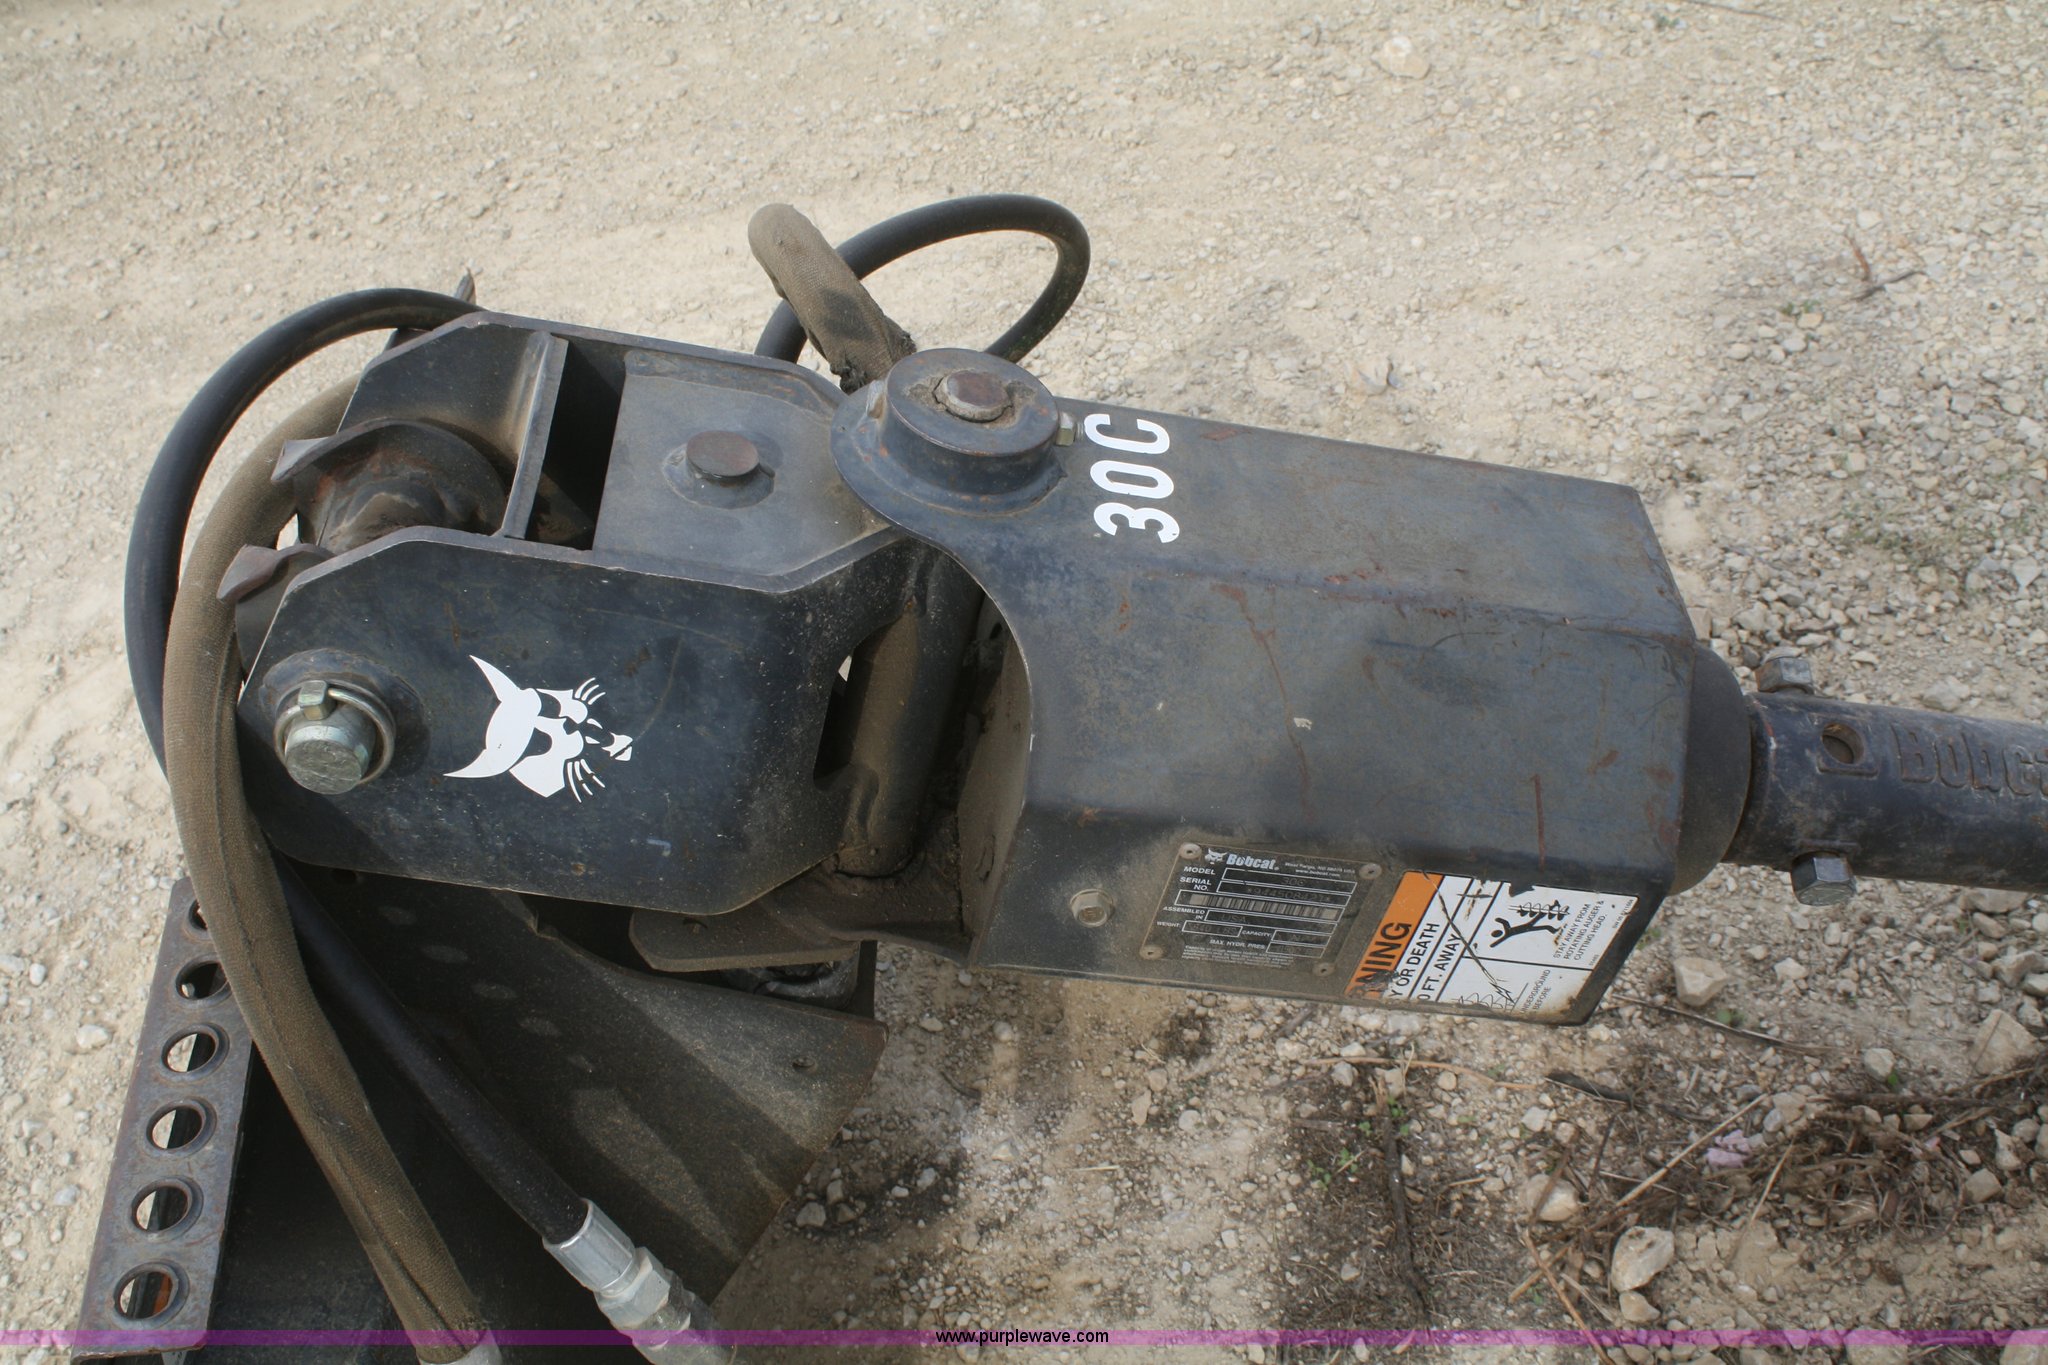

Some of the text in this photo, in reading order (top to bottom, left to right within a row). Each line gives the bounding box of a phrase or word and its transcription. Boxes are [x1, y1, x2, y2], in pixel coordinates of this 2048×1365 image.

[1084, 413, 1180, 544] 30C
[1183, 866, 1216, 876] MODEL
[1226, 853, 1275, 870] Bobcat
[1180, 876, 1212, 886] SERIAL
[1193, 884, 1209, 892] NO.
[1163, 906, 1206, 915] ASSEMBLED
[1553, 904, 1591, 959] STAY AWAY FROM
[1563, 929, 1586, 960] ROTATING
[1583, 907, 1601, 928] AUGER
[1396, 968, 1415, 987] OR
[1406, 923, 1440, 966] DEATH
[1434, 933, 1462, 971] AWAY
[1574, 934, 1595, 961] CUTTING
